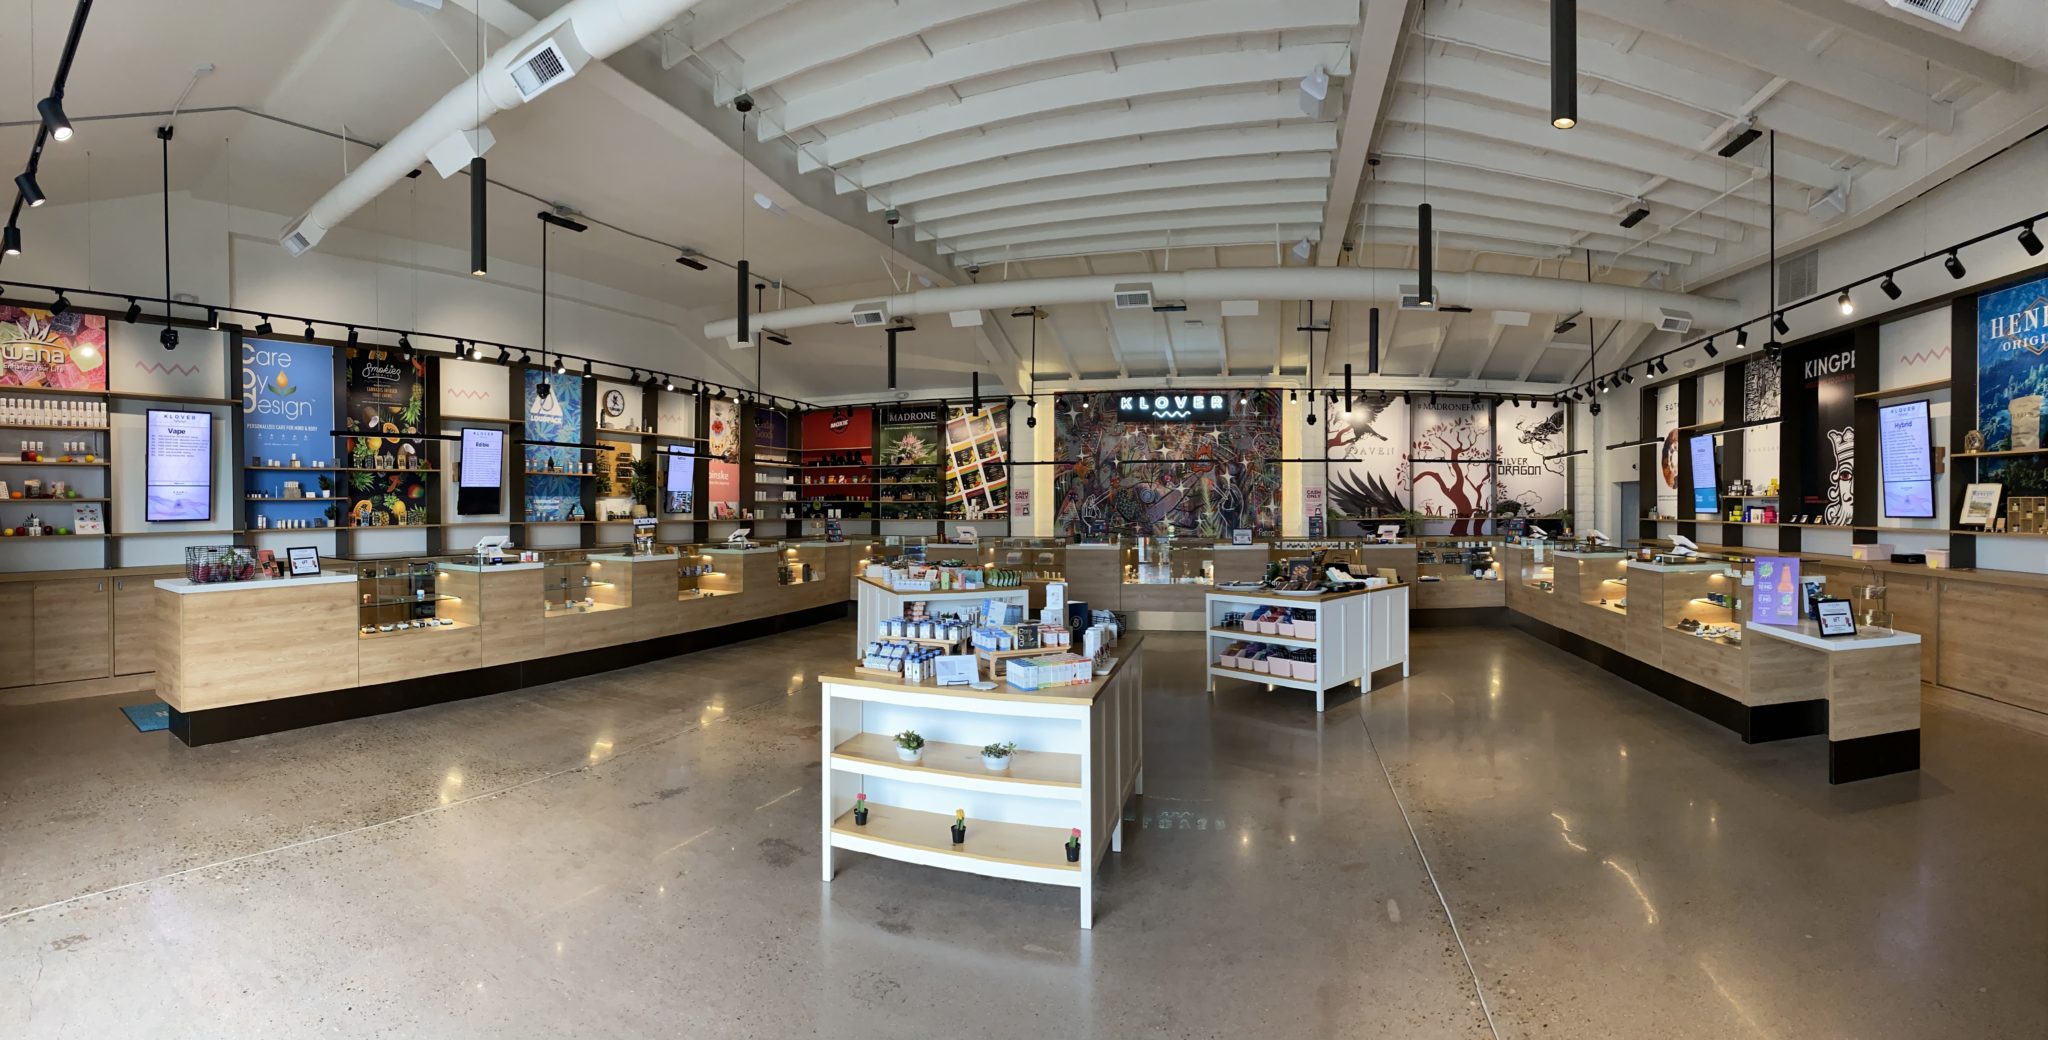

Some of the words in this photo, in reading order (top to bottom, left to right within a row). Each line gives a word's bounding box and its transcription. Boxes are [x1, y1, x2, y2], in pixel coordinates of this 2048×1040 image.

[242, 343, 291, 368] Care
[1120, 395, 1224, 410] KLOVER
[889, 411, 937, 422] MADRONE
[1498, 457, 1528, 466] SILVER
[1498, 465, 1542, 476] DRAGON
